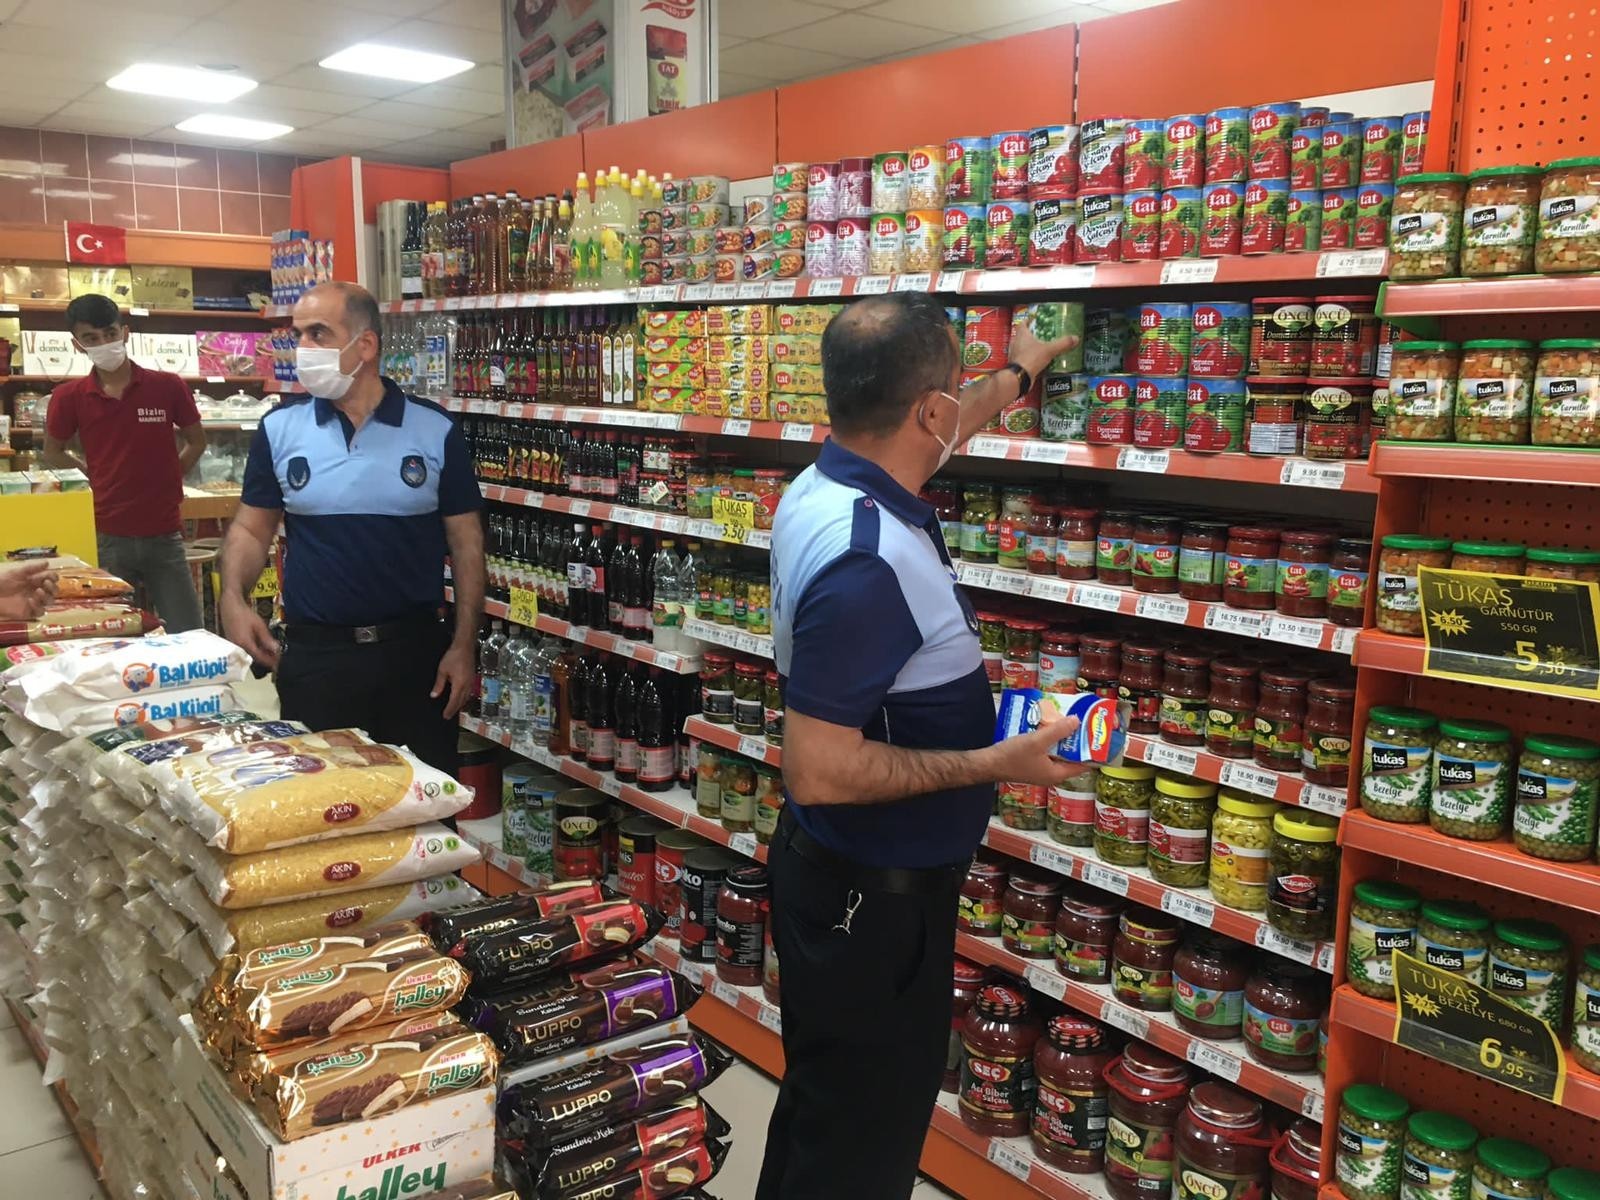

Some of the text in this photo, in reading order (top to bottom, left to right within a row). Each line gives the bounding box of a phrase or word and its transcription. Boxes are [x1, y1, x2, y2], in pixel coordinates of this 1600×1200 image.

[661, 64, 675, 74] TAT
[1251, 113, 1273, 130] tat
[1170, 125, 1192, 139] tat
[1366, 127, 1384, 140] tat
[1323, 133, 1338, 145] tat
[1003, 140, 1026, 153] tat
[885, 162, 900, 172] tat
[911, 158, 925, 168] tat
[1209, 193, 1232, 206] tat
[1324, 197, 1339, 209] tat
[1360, 194, 1378, 205] tat
[1135, 201, 1155, 213] tat
[946, 213, 961, 226] tat
[989, 210, 1006, 223] tat
[878, 223, 894, 233] tat
[1141, 313, 1156, 327] tat
[1194, 312, 1216, 326] tat
[1101, 384, 1125, 398] tat
[1136, 385, 1153, 400] tat
[1187, 388, 1203, 402] tat
[1313, 391, 1349, 403] ÖNCÜ
[137, 408, 166, 418] Bizim
[1156, 550, 1170, 559] tat
[1228, 561, 1239, 570] tat
[1289, 567, 1303, 576] tat
[1339, 576, 1357, 587] tat
[1480, 605, 1554, 622] GARNÜTÜR
[1440, 616, 1463, 626] 6.50
[1500, 622, 1538, 634] 550 GR
[159, 657, 229, 683] Bal Küpü
[150, 704, 177, 721] Bal
[1373, 782, 1403, 798] Bezelye
[332, 804, 354, 816] AKIN
[1440, 800, 1470, 814] Bezelye
[331, 863, 353, 875] AKIN
[498, 938, 554, 962] LUPPO
[1177, 983, 1191, 995] tat
[394, 984, 446, 1008] halley
[1438, 995, 1534, 1036] BEZELYE 680 GR
[523, 1015, 582, 1046] LUPPO
[1270, 1020, 1289, 1032] tat
[306, 1049, 366, 1073] halley
[1479, 1037, 1525, 1079] 6,95
[429, 1063, 481, 1089] halley
[972, 1063, 1001, 1081] SEÇ
[982, 1085, 1009, 1098] Biber
[551, 1089, 612, 1120] LUPPO
[982, 1093, 1009, 1105] Salçası
[1039, 1088, 1065, 1109] SEÇ
[551, 1126, 615, 1157] Sandviç Kek
[558, 1156, 616, 1189] LUPPO
[337, 1161, 447, 1200] halley
[1186, 1173, 1222, 1200] ÖNCÜ
